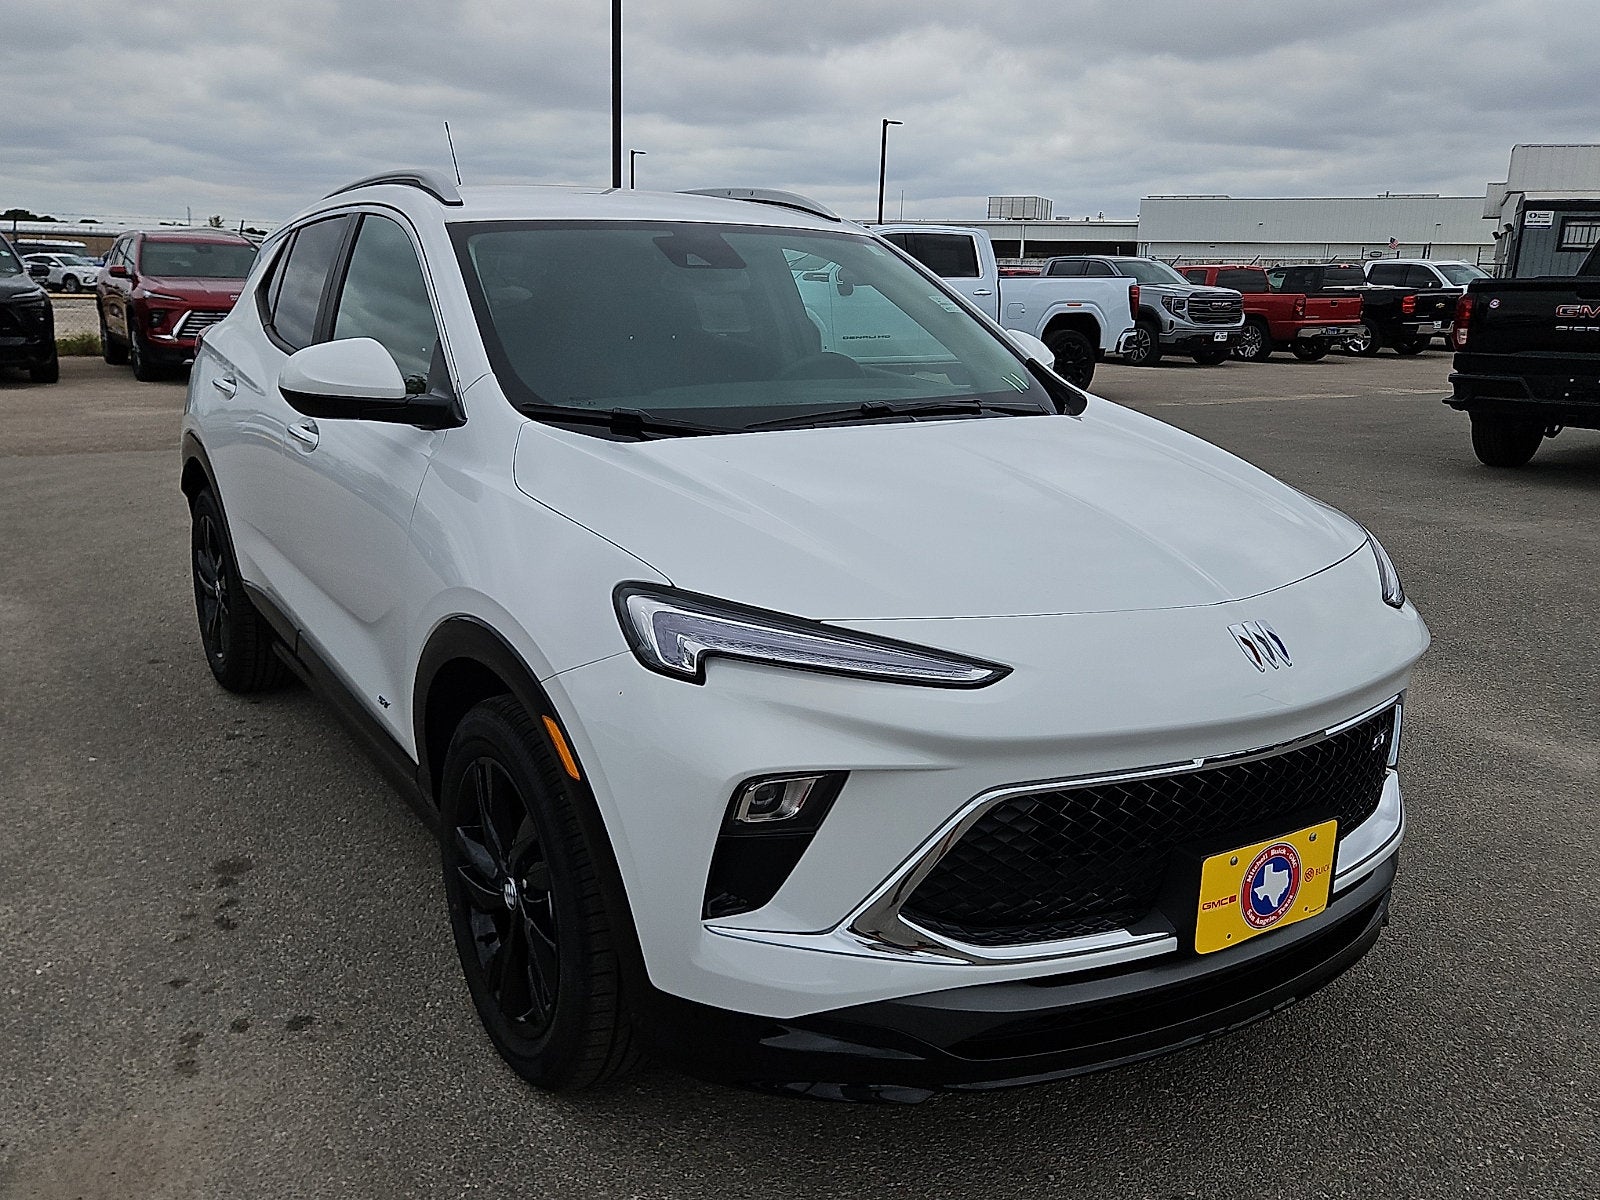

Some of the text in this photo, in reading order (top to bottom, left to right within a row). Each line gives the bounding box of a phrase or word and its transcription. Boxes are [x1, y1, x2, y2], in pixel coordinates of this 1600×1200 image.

[1246, 853, 1268, 883] Mitchell
[1270, 847, 1287, 856] Buick
[1315, 864, 1330, 875] BUICK
[1202, 897, 1228, 910] GMC
[1246, 908, 1256, 922] San
